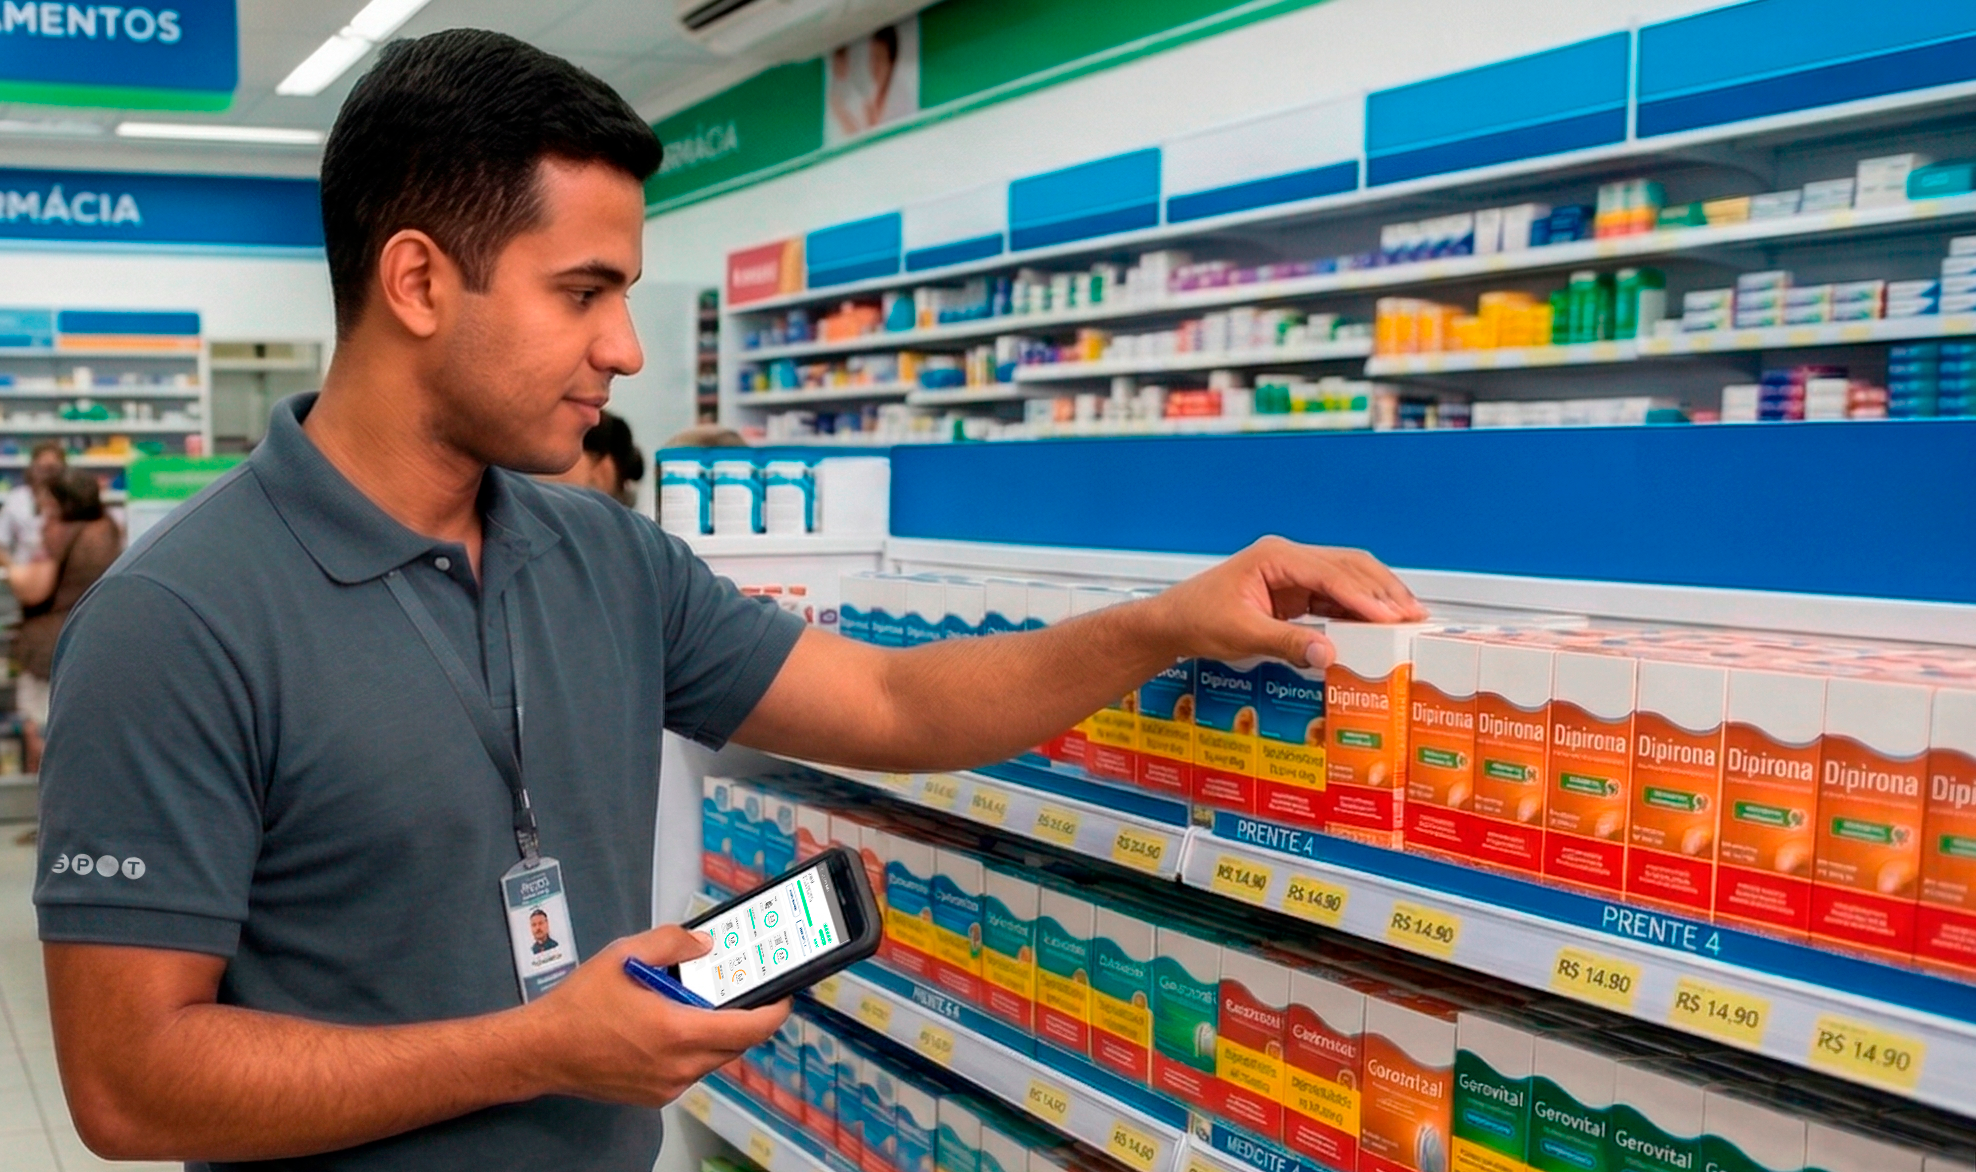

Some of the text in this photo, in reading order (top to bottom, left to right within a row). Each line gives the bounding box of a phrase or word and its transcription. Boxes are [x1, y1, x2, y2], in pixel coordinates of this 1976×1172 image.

[0, 1, 181, 43] MENTOS
[0, 183, 141, 226] MÁCIA
[1265, 681, 1324, 701] Dipirona
[1328, 685, 1390, 712] Dipirona
[1412, 701, 1474, 729] Dipirona
[1479, 712, 1544, 742] Dipirona
[1554, 723, 1626, 754] Dipirona
[1638, 734, 1715, 767] Dipirona
[1727, 747, 1813, 781] Dipirona
[1824, 759, 1918, 797] Dipirona
[1237, 819, 1301, 853] PRENTE
[1391, 912, 1454, 943] R$ 14.90
[1601, 904, 1721, 957] PRENTE 4
[1557, 958, 1631, 994] R$ 14.90
[1675, 990, 1759, 1029] R$ 14.90
[1817, 1030, 1911, 1072] R$ 14.90
[1459, 1074, 1524, 1107] Gerovital
[1534, 1100, 1605, 1138] Gerovital
[1227, 1134, 1287, 1172] MEDCITE
[1615, 1129, 1693, 1169] Gerovital
